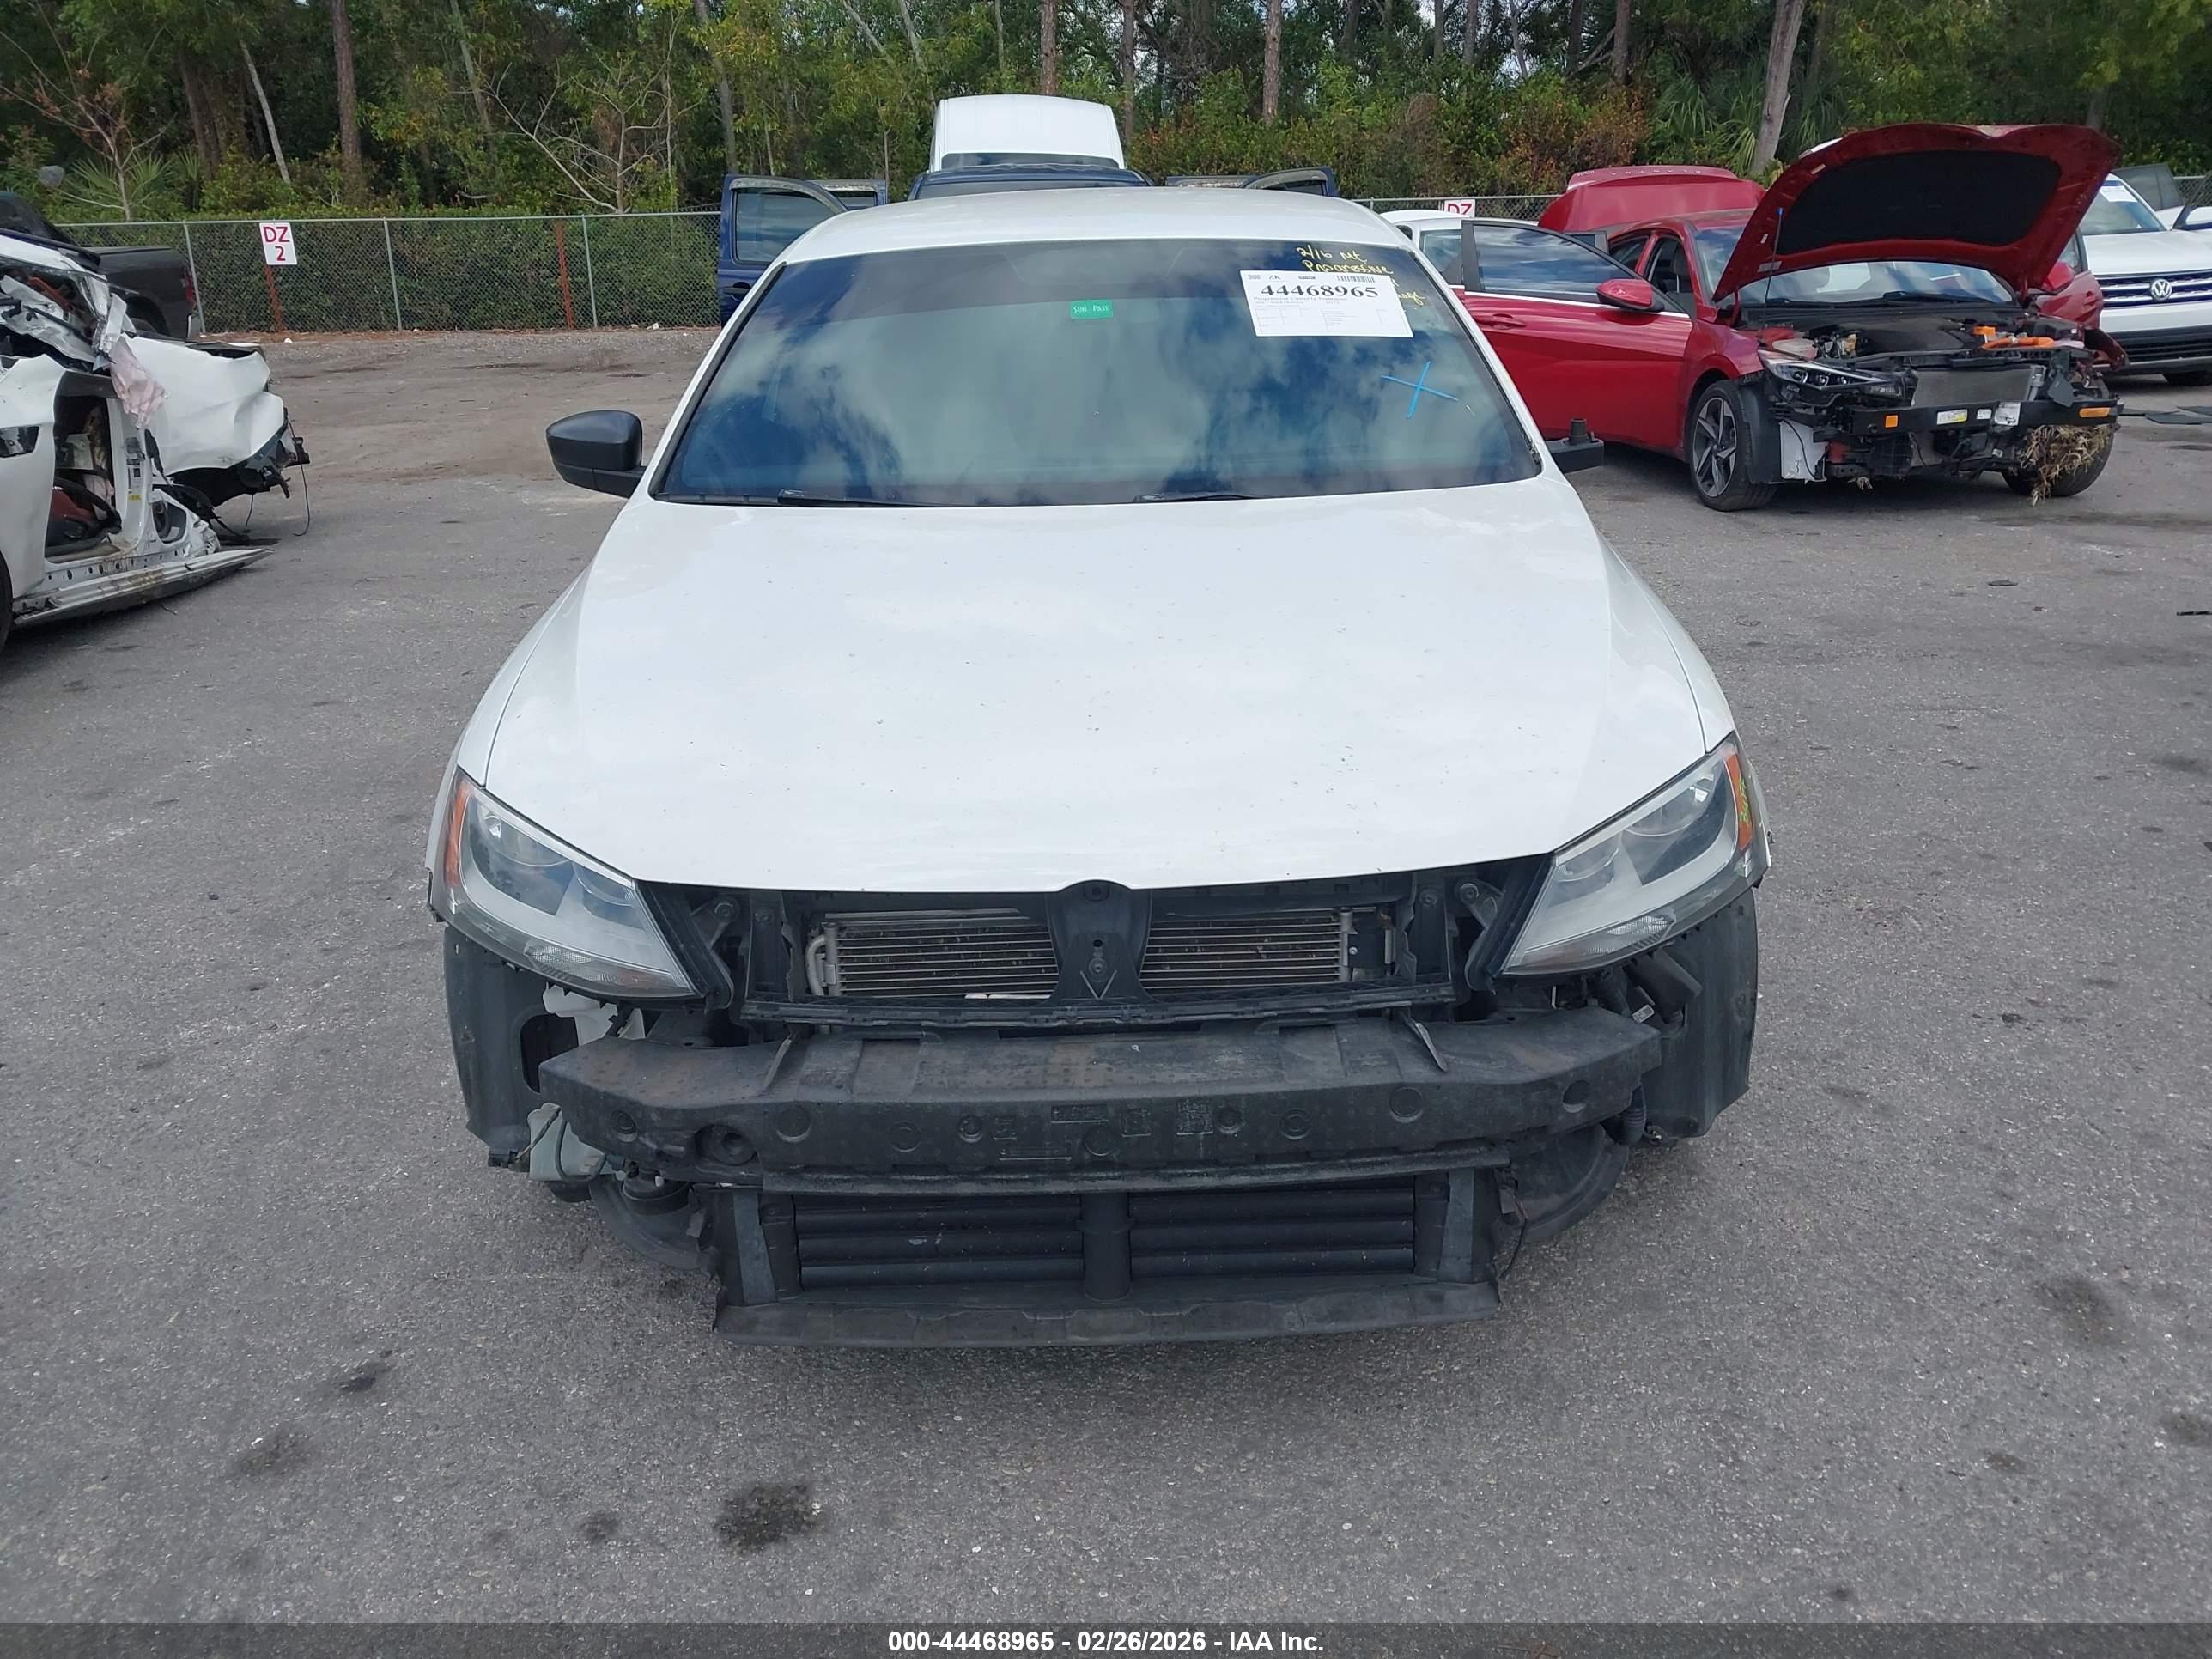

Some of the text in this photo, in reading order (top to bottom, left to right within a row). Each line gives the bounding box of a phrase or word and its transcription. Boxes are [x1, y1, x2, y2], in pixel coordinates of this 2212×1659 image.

[1448, 203, 1472, 215] DZ
[263, 226, 290, 243] DZ
[274, 245, 286, 262] 2
[1261, 285, 1379, 297] 44468965
